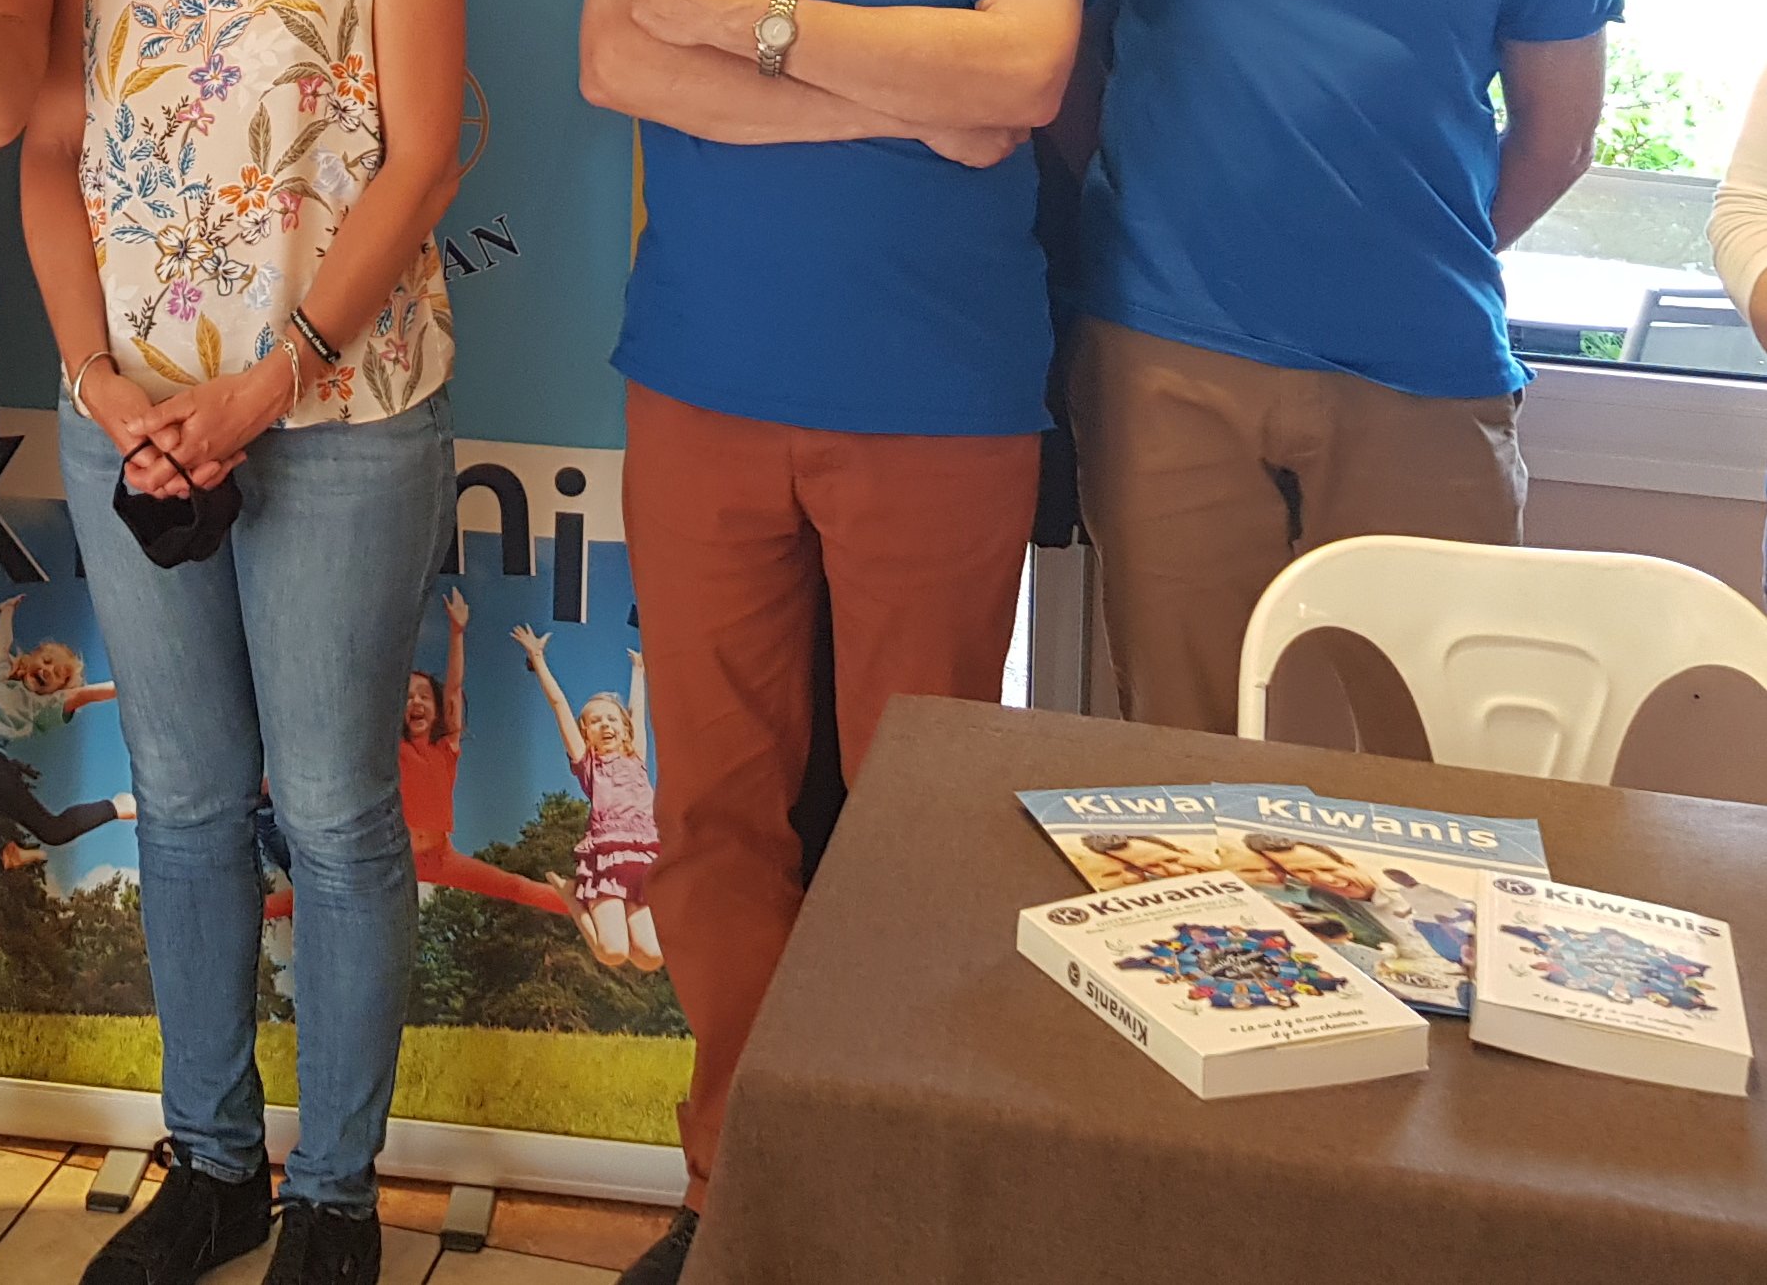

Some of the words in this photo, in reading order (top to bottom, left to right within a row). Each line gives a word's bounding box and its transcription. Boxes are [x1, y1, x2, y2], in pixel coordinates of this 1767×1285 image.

[442, 214, 522, 282] AN
[1063, 793, 1215, 815] Kiwa
[1256, 795, 1500, 850] Kiwanis
[1089, 878, 1245, 917] Kiwanis
[1545, 886, 1722, 938] Kiwanis
[1085, 980, 1149, 1047] Kiwanis
